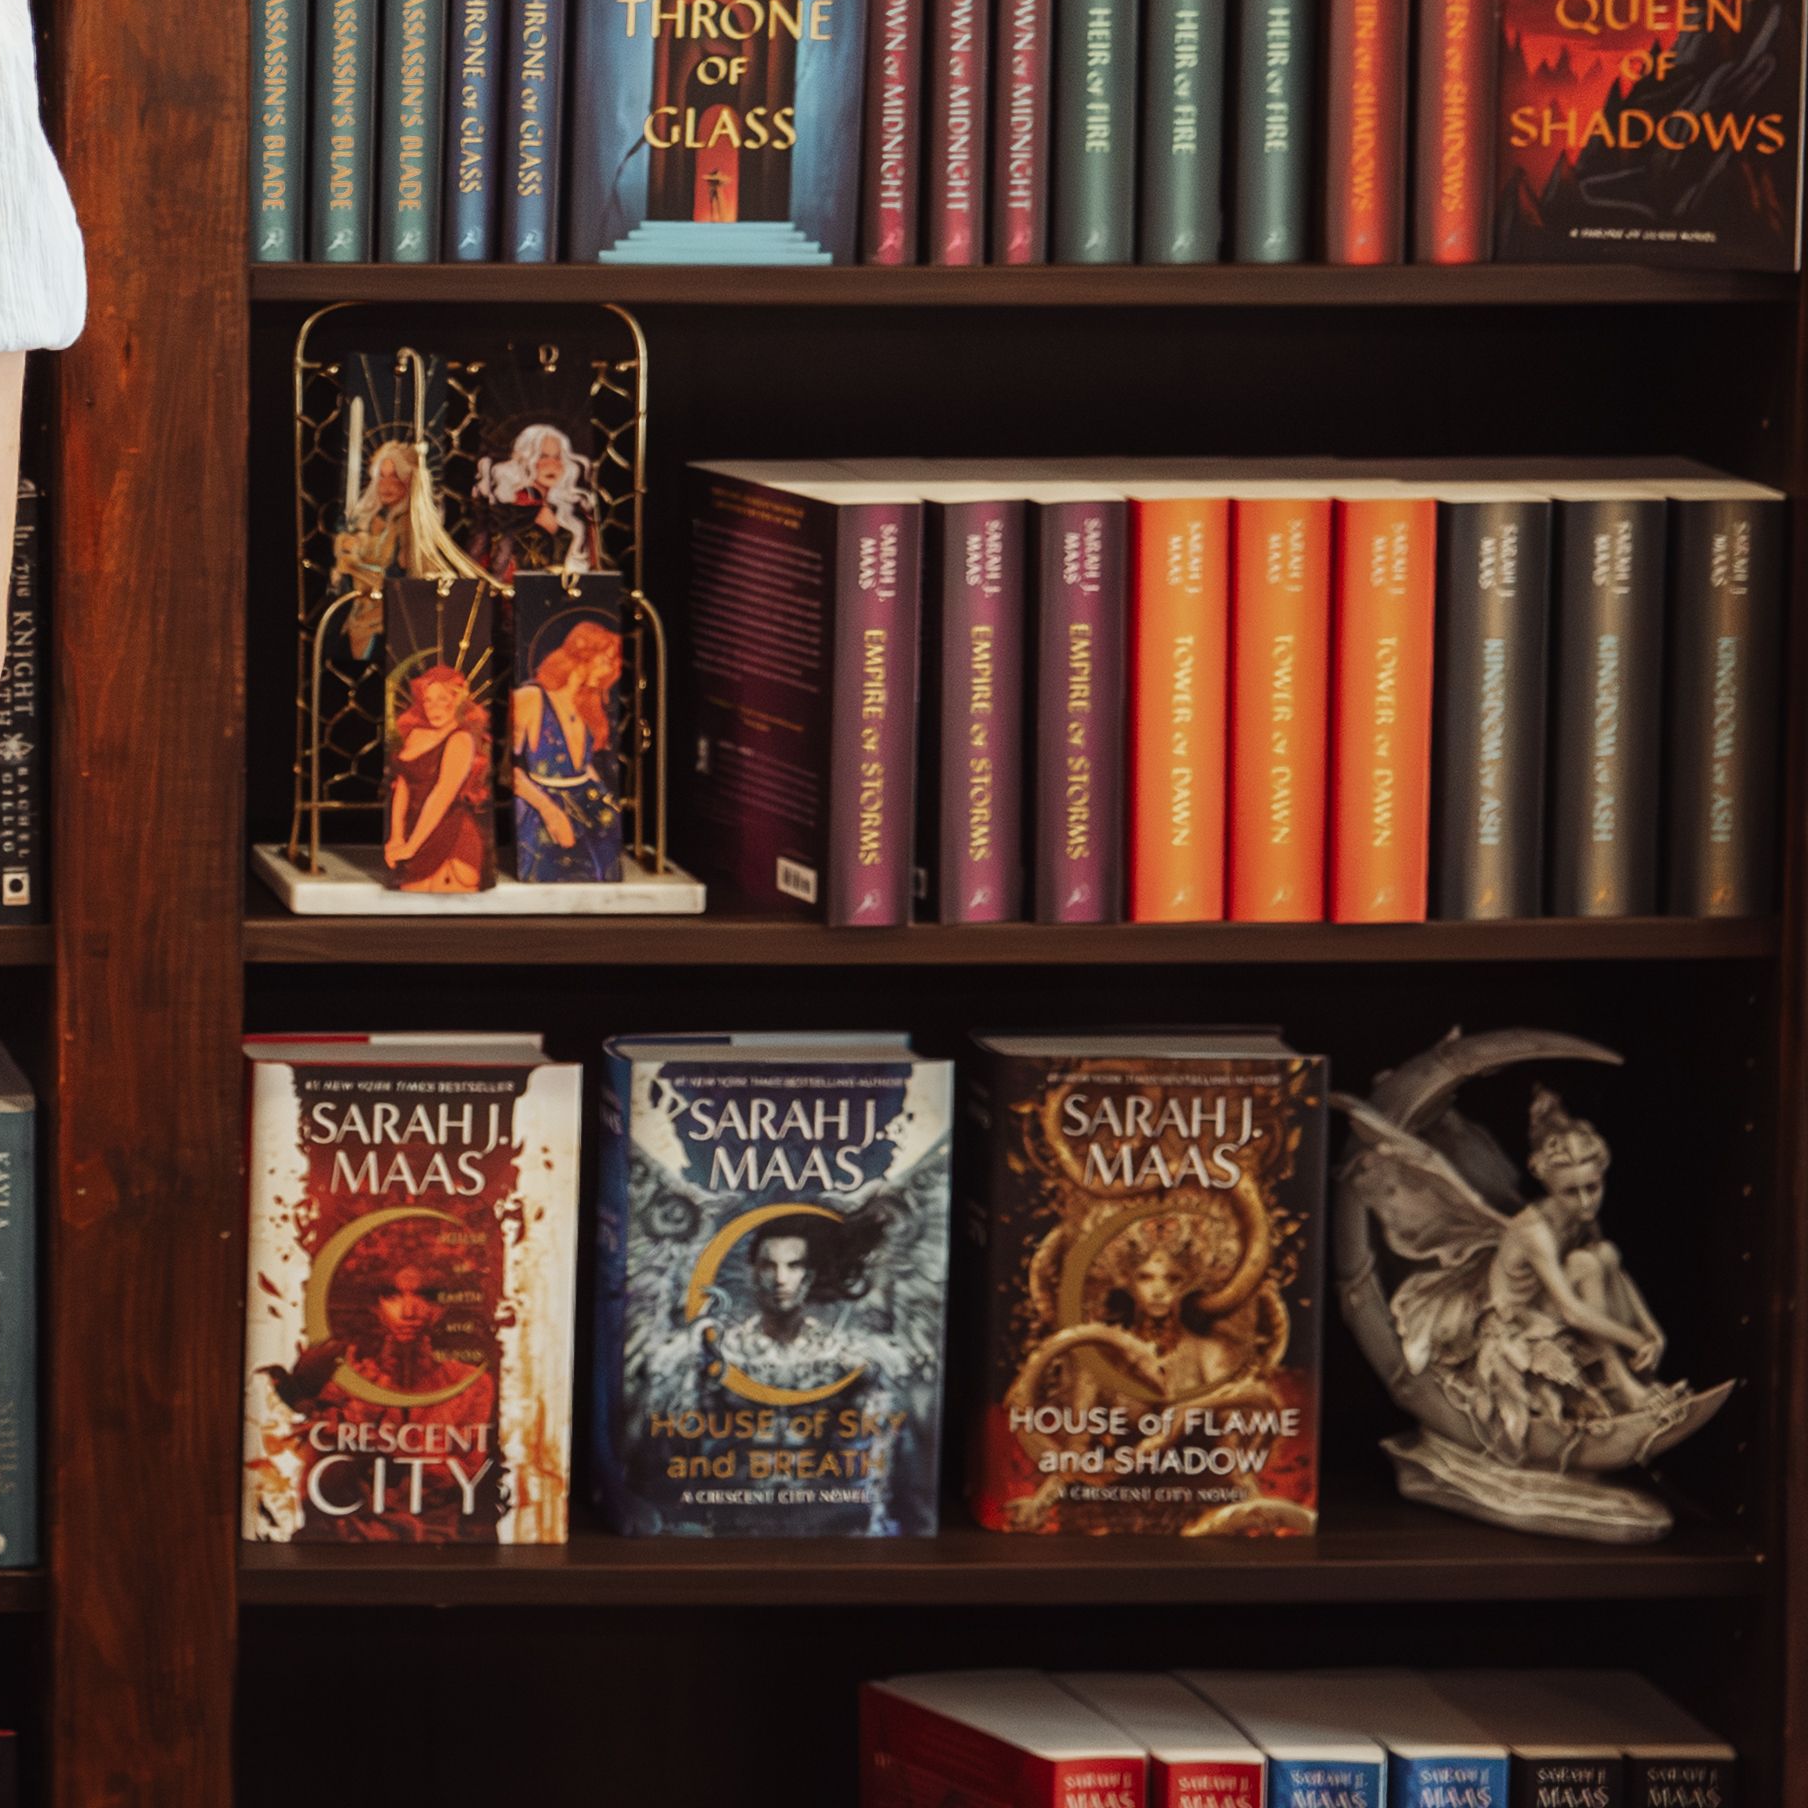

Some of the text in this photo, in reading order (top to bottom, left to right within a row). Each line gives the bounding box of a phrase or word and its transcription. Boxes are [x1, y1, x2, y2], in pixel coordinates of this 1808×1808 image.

[696, 56, 748, 86] OF
[1619, 50, 1679, 81] OF
[642, 106, 799, 150] GLASS
[1509, 106, 1786, 155] SHADOWS
[311, 1102, 510, 1154] SARAH J.
[1062, 1093, 1263, 1149] SARAH J.
[331, 1151, 487, 1197] MAAS
[1082, 1142, 1242, 1191] MAAS
[308, 1421, 495, 1453] CRESCENT
[1009, 1407, 1300, 1437] HOUSE of FLAME
[1038, 1444, 1268, 1476] and SHADOW
[307, 1456, 495, 1516] CITY
